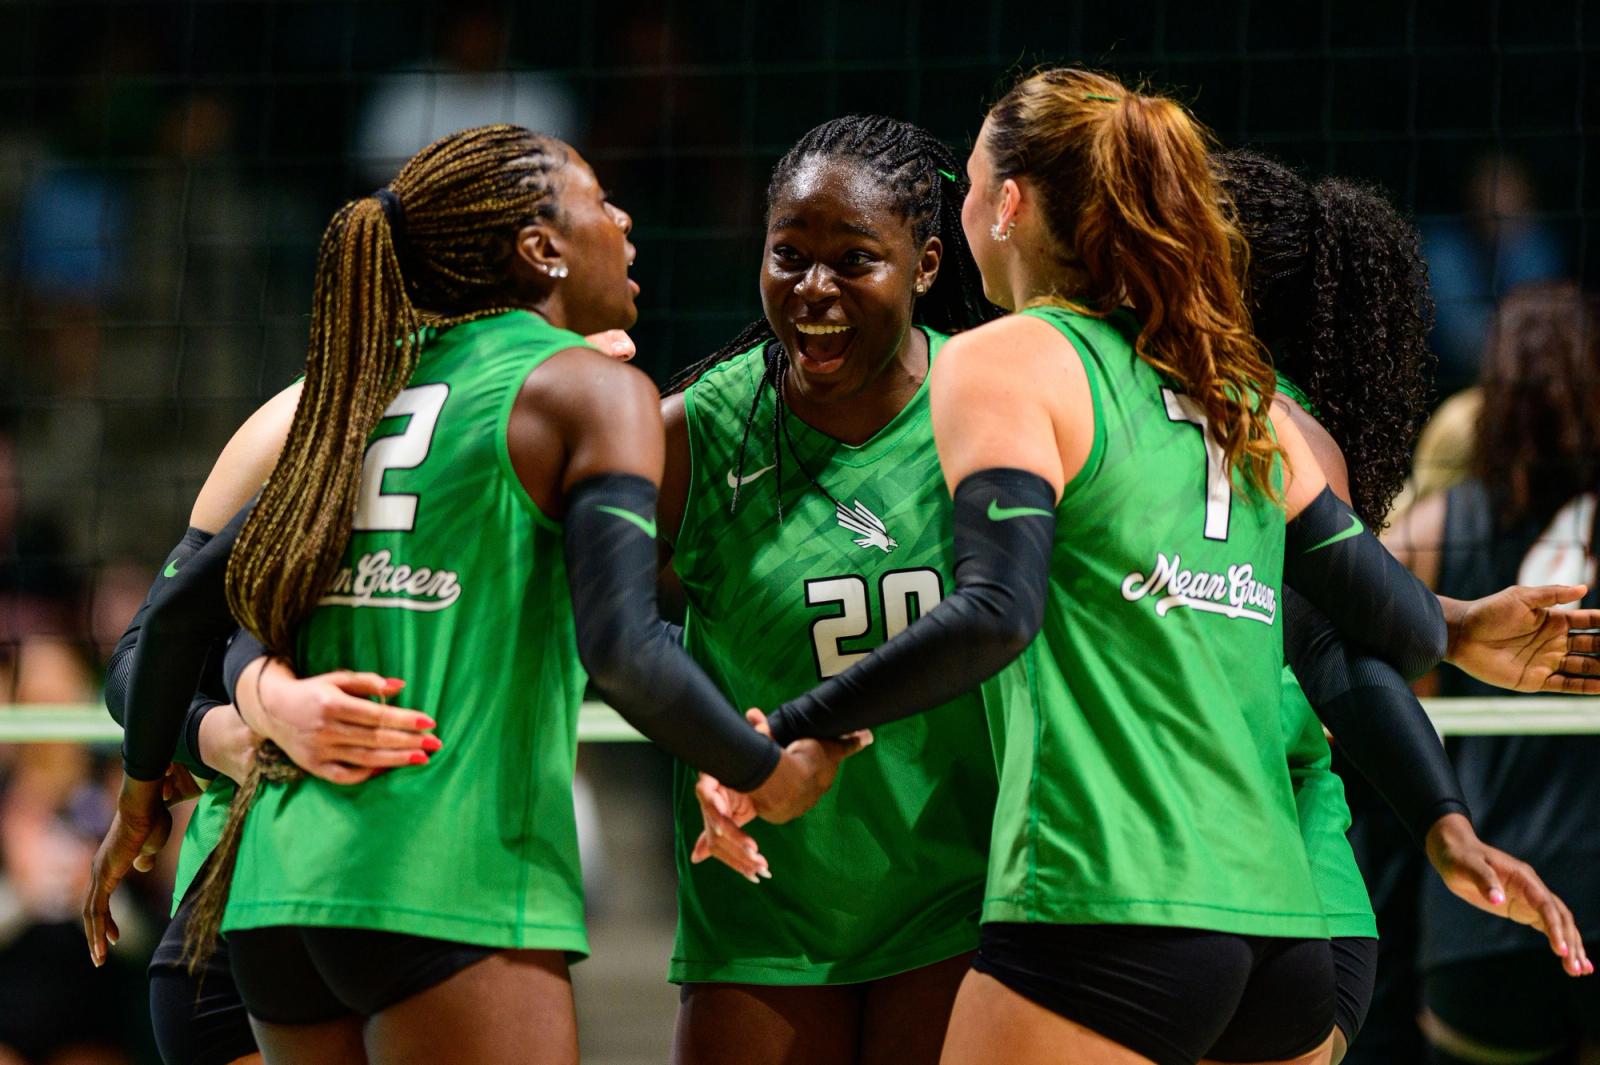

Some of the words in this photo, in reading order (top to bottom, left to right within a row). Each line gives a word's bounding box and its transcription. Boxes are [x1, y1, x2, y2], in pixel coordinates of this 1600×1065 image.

[351, 383, 450, 532] 2
[803, 566, 945, 681] 20
[1121, 551, 1228, 603] Mean
[1226, 563, 1277, 616] Green
